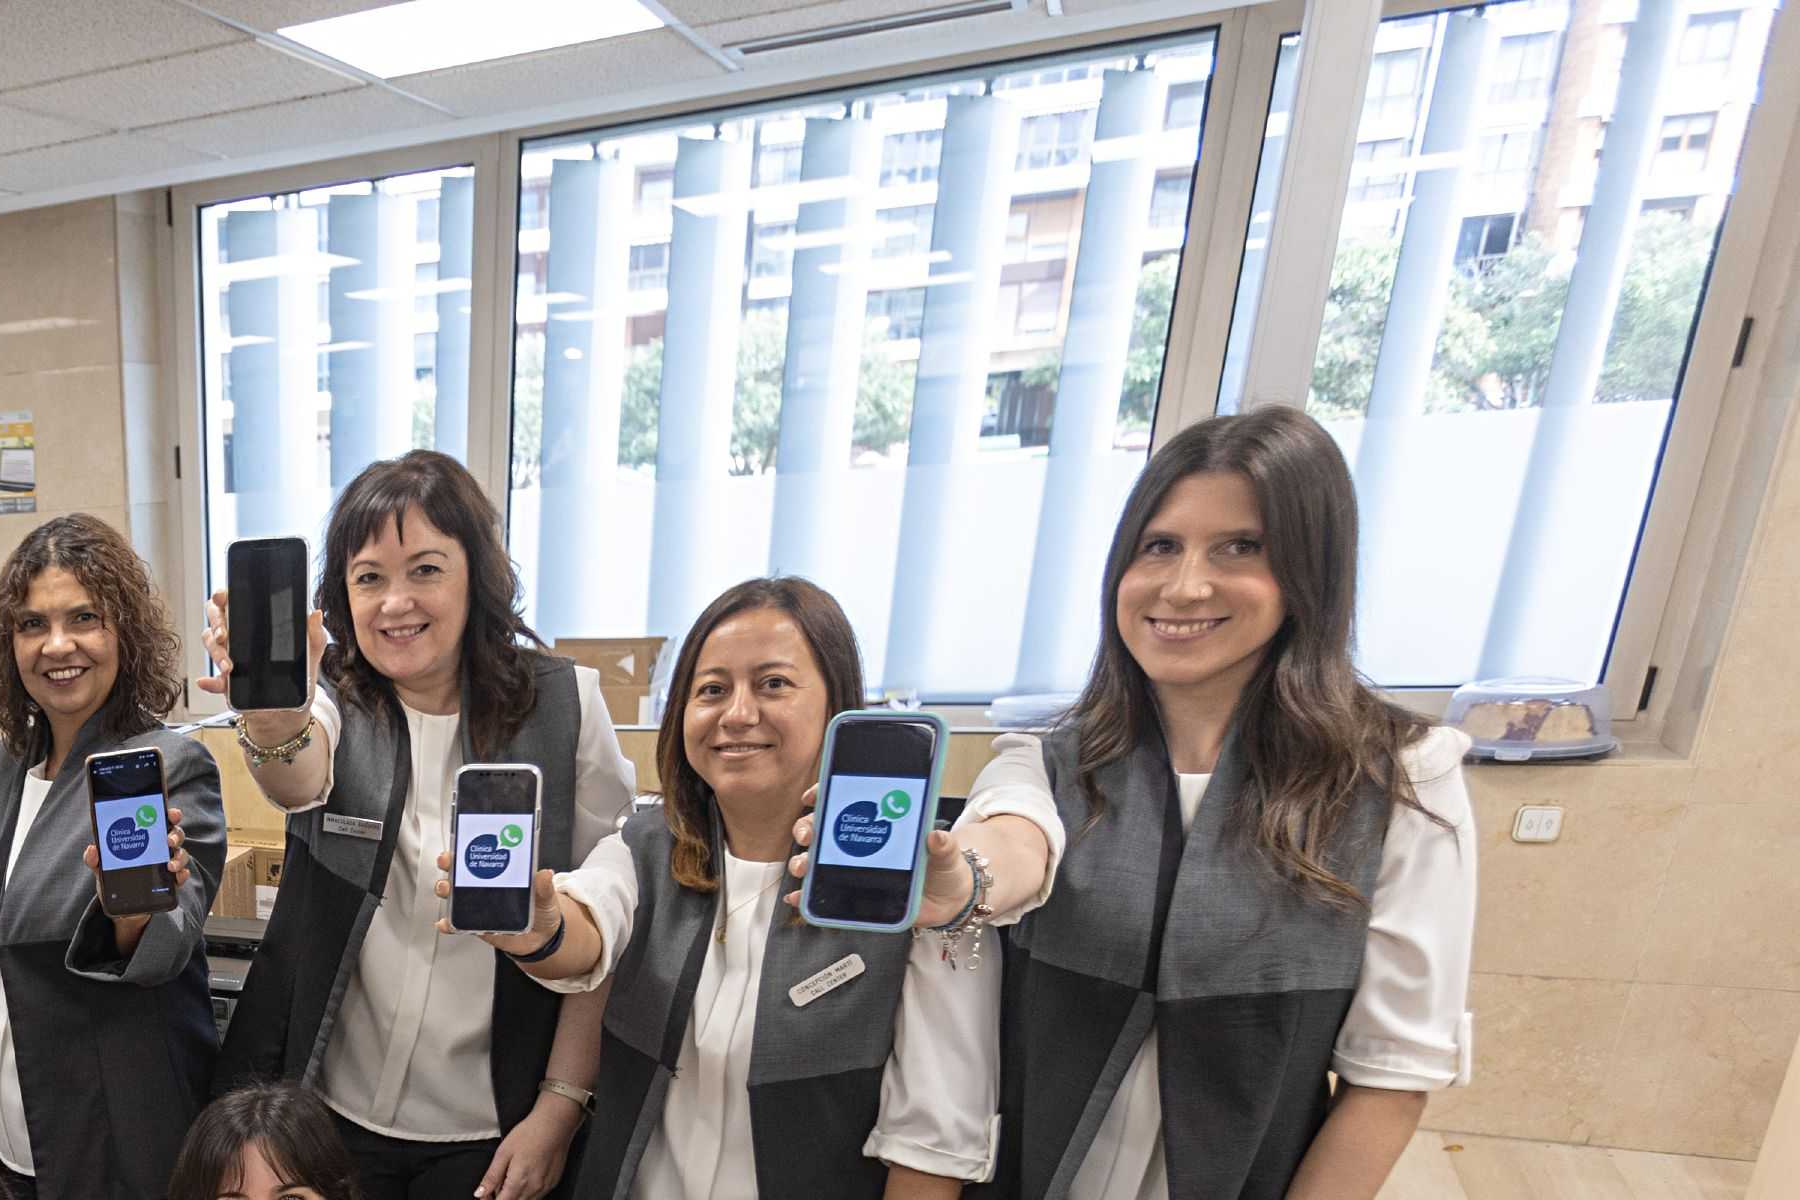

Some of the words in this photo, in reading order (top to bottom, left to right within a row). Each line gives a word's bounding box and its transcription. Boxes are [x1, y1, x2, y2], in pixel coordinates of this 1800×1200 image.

[840, 824, 888, 833] Universidad
[111, 833, 146, 844] Universidad
[838, 833, 848, 841] de
[850, 834, 882, 843] Navarra
[121, 841, 145, 850] Navarra
[470, 852, 507, 860] Universidad
